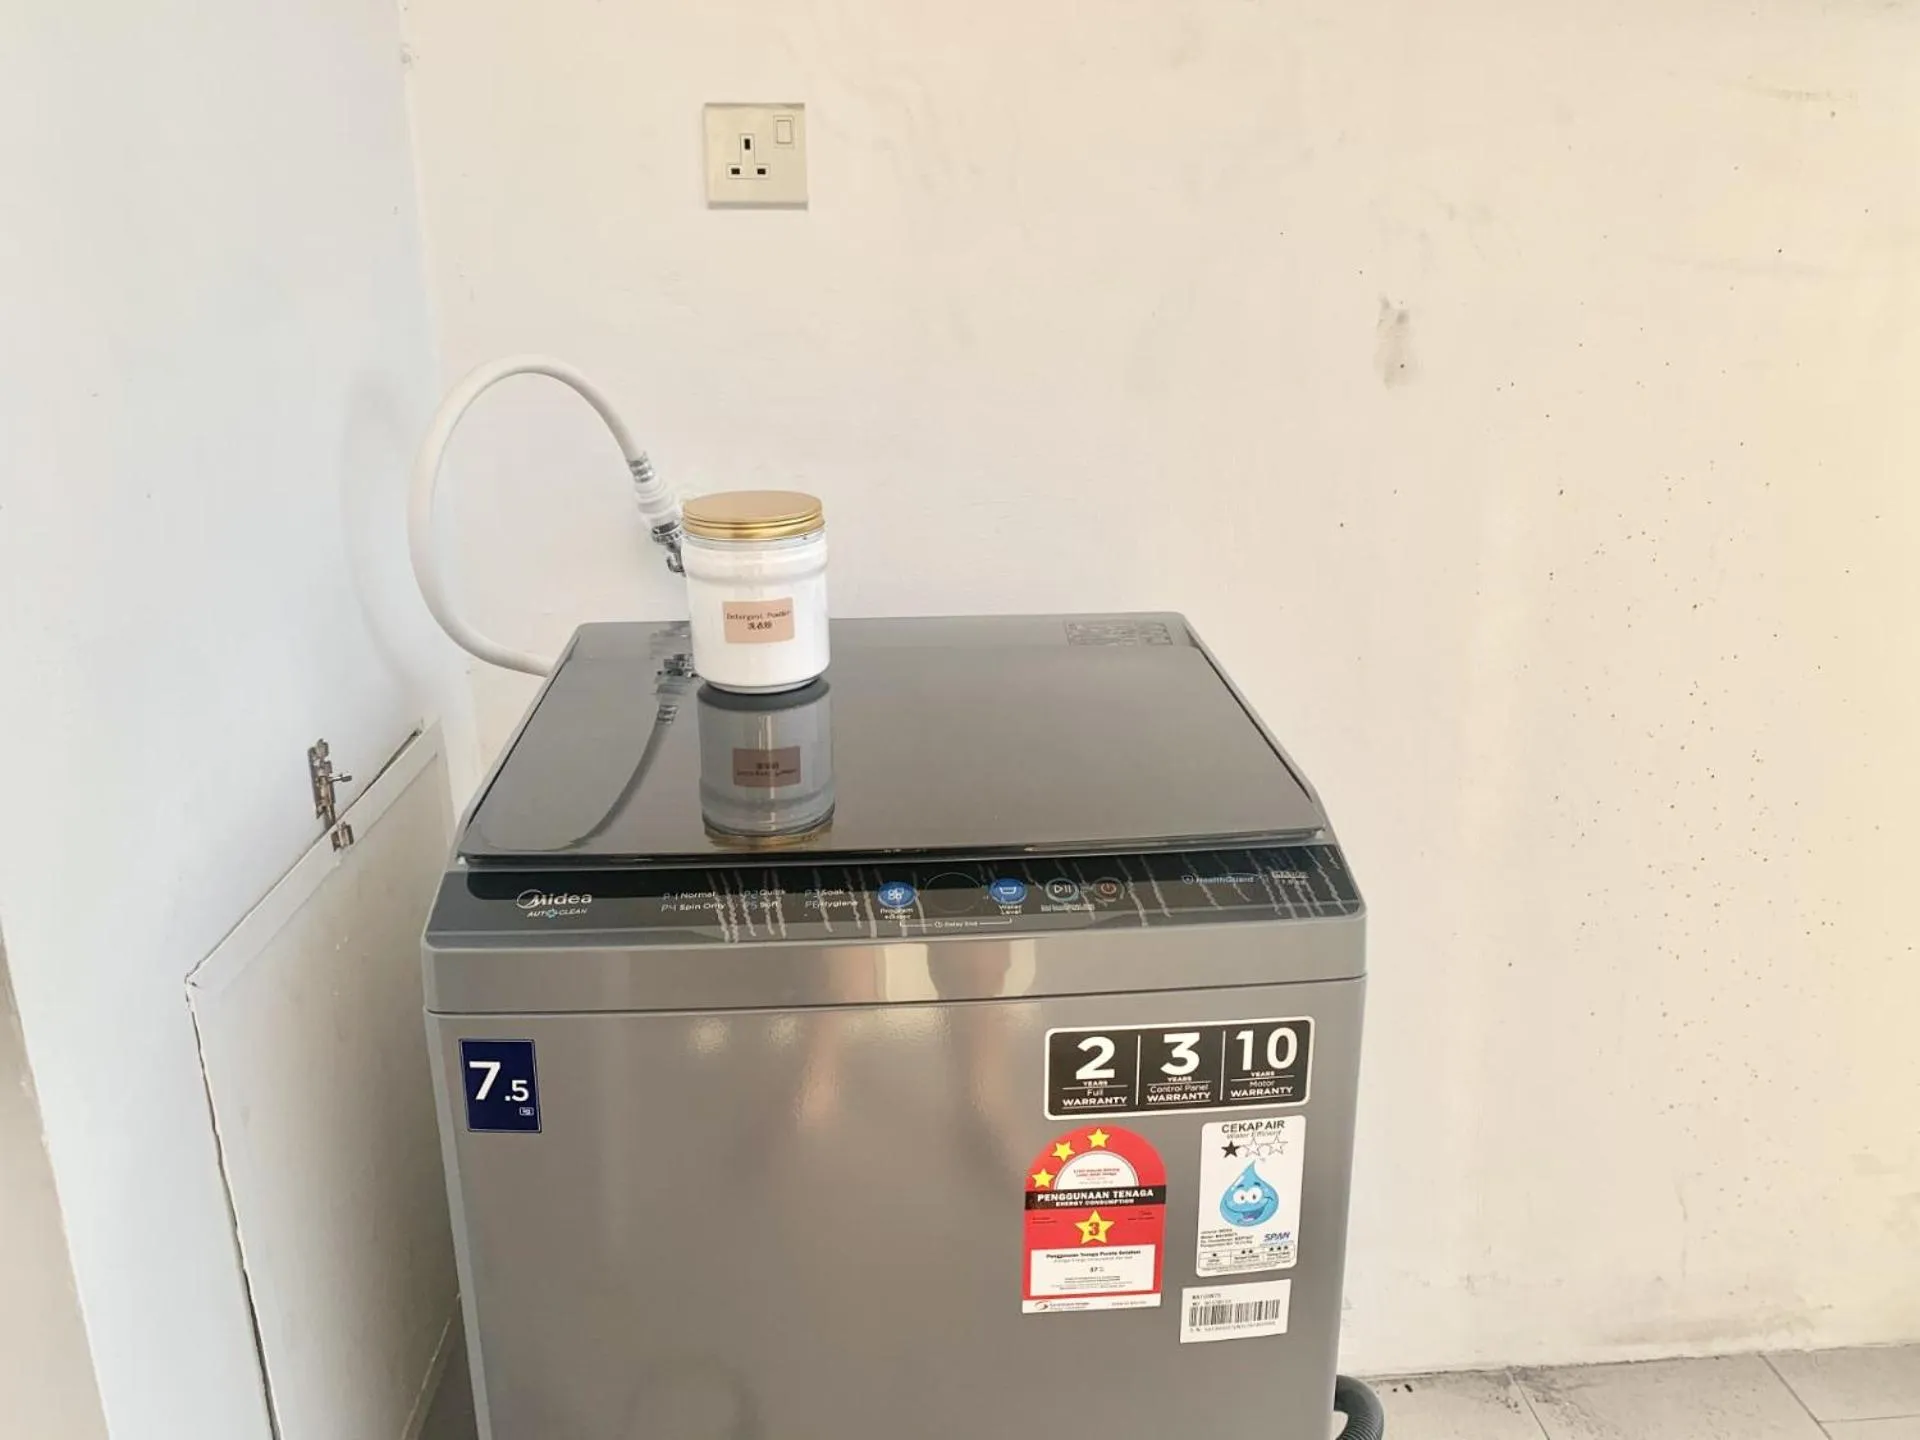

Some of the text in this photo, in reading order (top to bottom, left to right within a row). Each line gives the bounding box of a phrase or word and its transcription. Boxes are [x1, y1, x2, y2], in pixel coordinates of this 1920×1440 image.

[516, 888, 593, 909] Midea
[680, 890, 715, 900] Normal
[1160, 1031, 1201, 1076] 3
[1236, 1026, 1298, 1071] 10
[1075, 1035, 1116, 1081] 2
[468, 1060, 529, 1102] 7.5
[1150, 1083, 1209, 1094] Control Panel
[1231, 1086, 1292, 1098] WARRANTY
[1062, 1095, 1127, 1107] WARRANTY
[1147, 1091, 1210, 1103] WARRANTY
[1221, 1120, 1285, 1134] CEKAP AIR
[1037, 1189, 1154, 1202] PENGGUNAAN TENAGA
[1085, 1198, 1135, 1206] CONSUMPTION
[1088, 1222, 1100, 1236] 3
[1264, 1232, 1291, 1241] SPAN
